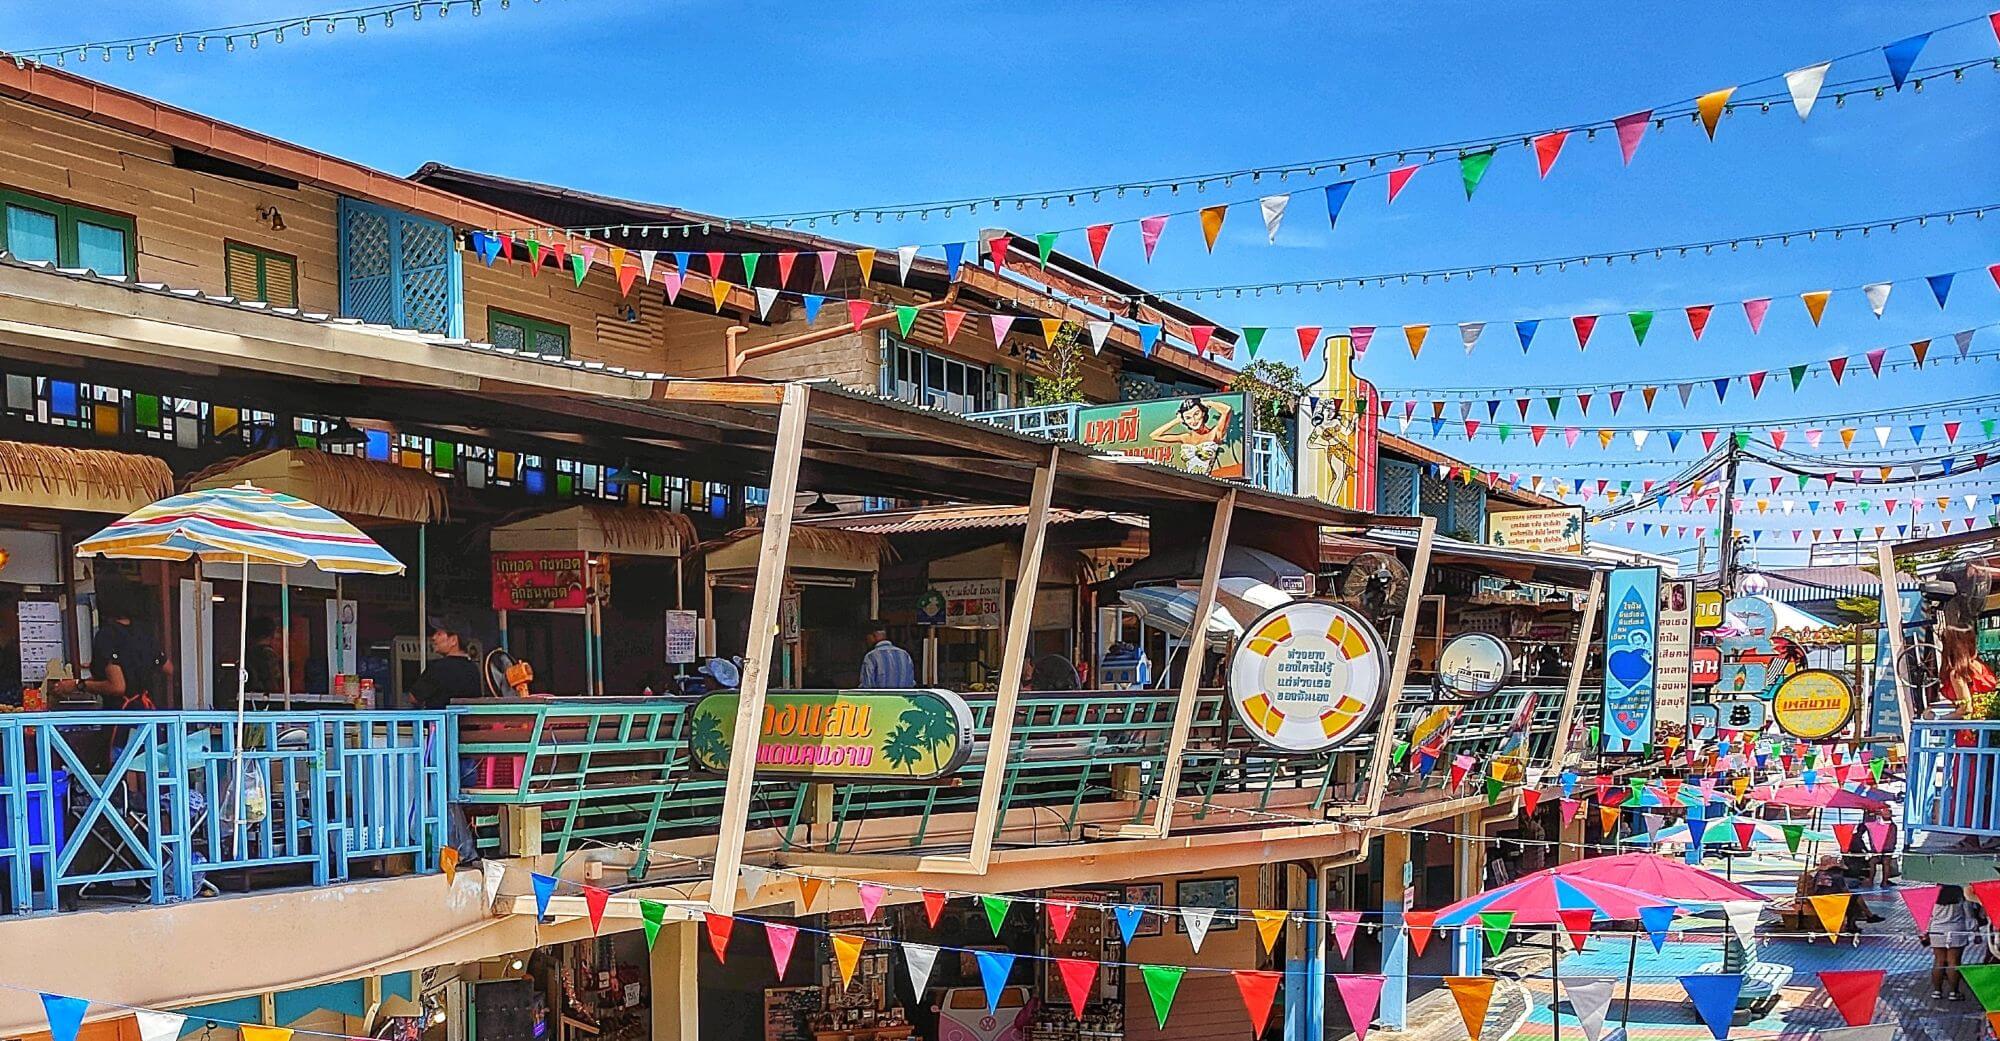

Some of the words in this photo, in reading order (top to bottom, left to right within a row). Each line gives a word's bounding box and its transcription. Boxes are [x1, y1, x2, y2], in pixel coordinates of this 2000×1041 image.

[1085, 408, 1138, 444] เทพี
[496, 557, 534, 572] ไก่ทอด
[1697, 602, 1721, 617] าด
[1278, 660, 1335, 677] ของใครไม่รู้
[1277, 690, 1329, 702] ของฉันเอง
[1783, 697, 1841, 710] เพลินวาน
[762, 702, 873, 738] างแสน
